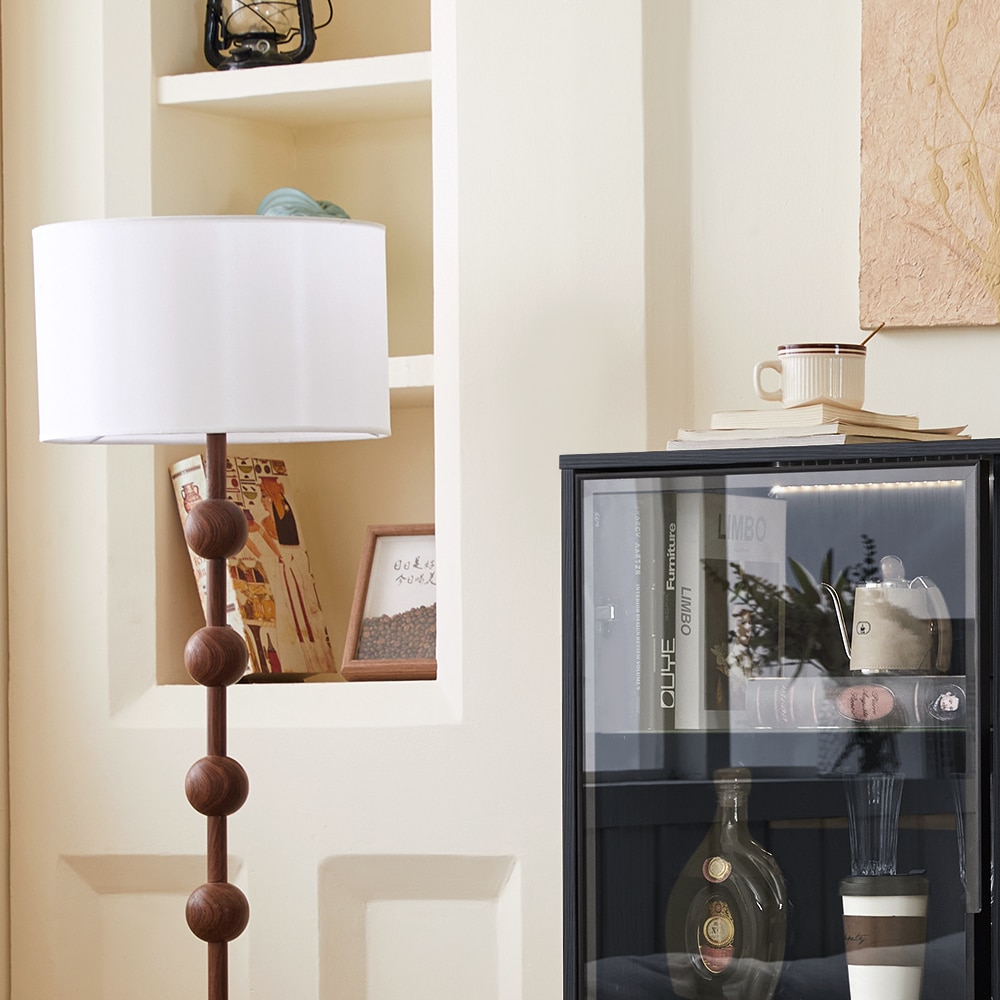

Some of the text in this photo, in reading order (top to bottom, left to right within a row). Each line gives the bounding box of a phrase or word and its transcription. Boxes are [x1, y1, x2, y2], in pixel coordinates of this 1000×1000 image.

[717, 512, 767, 543] LIMBO
[666, 523, 677, 592] Furniture
[680, 586, 692, 636] LIMBO
[660, 638, 676, 709] OUYE
